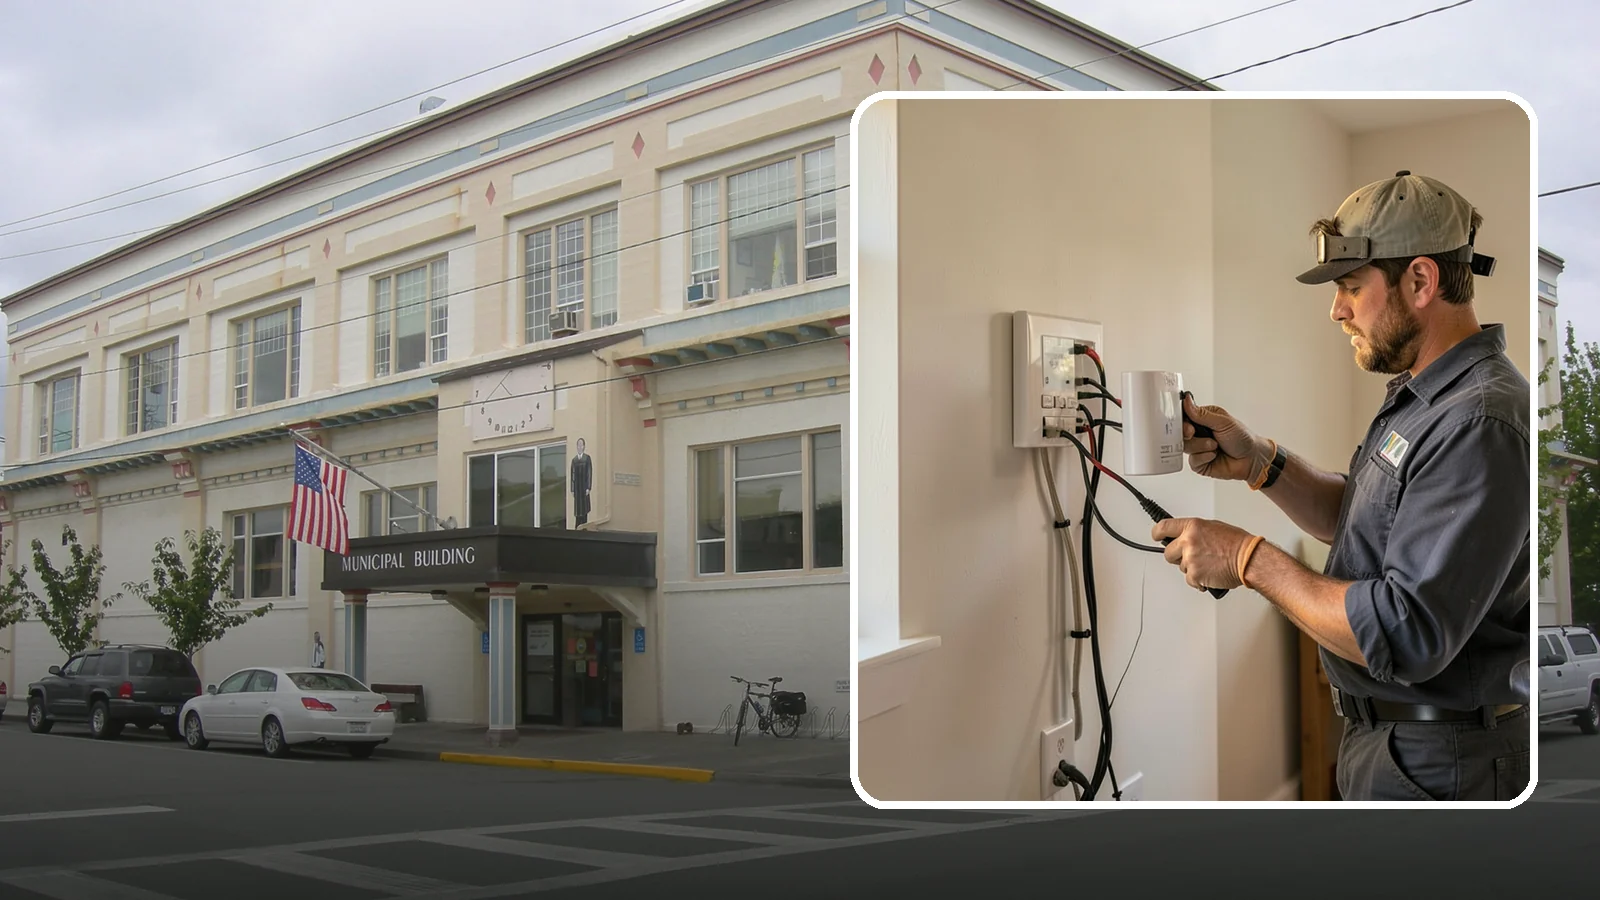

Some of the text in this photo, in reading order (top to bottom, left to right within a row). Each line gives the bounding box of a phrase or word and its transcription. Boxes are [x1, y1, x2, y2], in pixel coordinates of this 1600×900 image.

[476, 390, 479, 398] 7
[536, 402, 540, 410] 4
[481, 407, 485, 415] 8
[488, 418, 492, 426] 9
[529, 414, 533, 422] 3
[502, 426, 506, 434] 11
[342, 546, 475, 572] MUNICIPAL BUILDING
